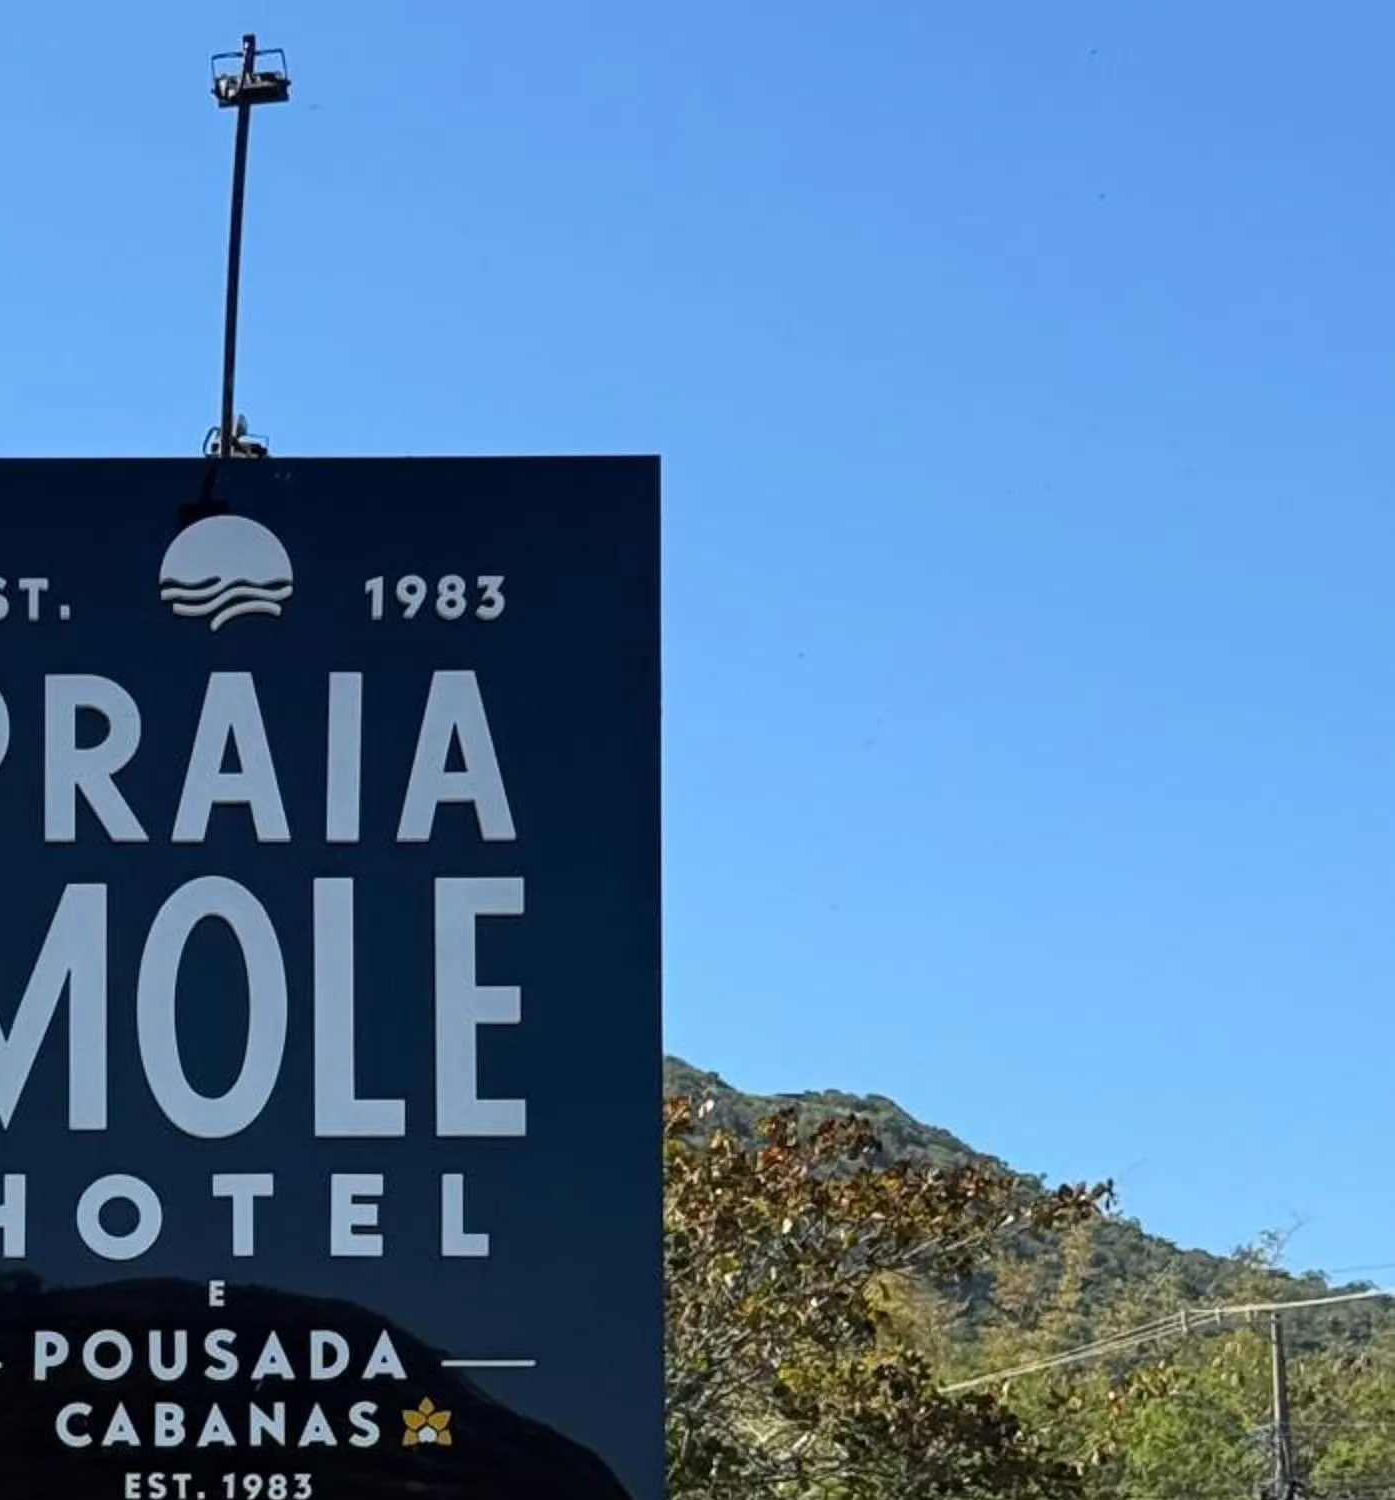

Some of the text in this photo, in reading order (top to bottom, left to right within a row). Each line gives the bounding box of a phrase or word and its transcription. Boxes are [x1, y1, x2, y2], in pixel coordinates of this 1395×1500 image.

[365, 574, 505, 620] 1983
[208, 1279, 226, 1307] E
[34, 1328, 407, 1382] POUSADA
[55, 1401, 380, 1448] CABANAS
